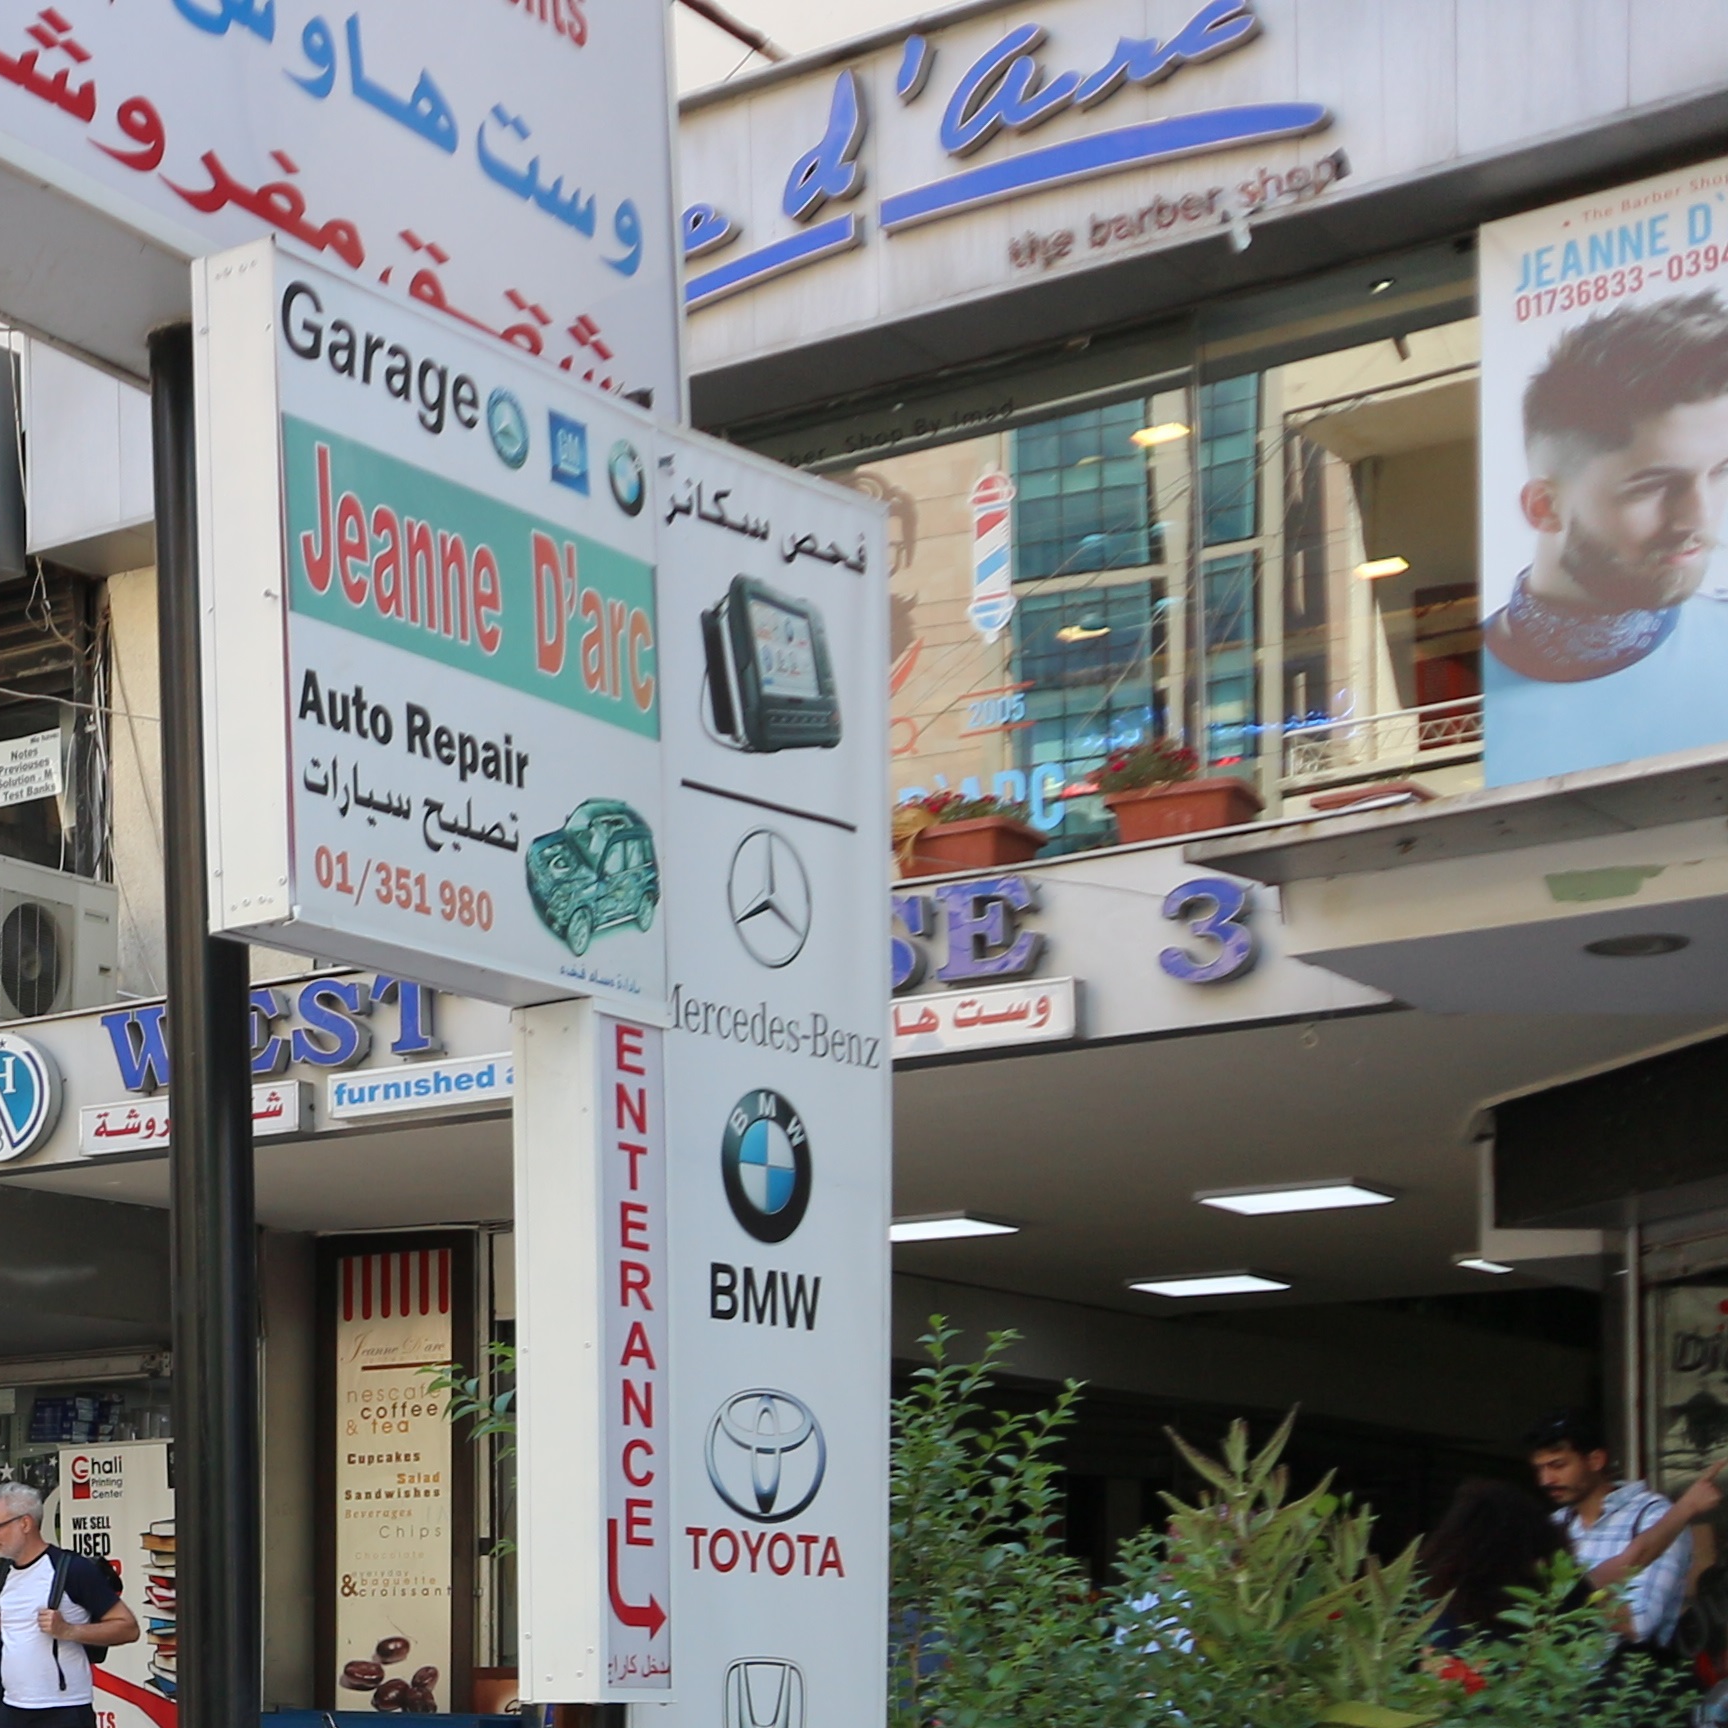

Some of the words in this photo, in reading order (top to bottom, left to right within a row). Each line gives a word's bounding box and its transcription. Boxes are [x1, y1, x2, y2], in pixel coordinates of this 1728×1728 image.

[477, 102, 642, 277] وست
[1582, 207, 1613, 223] The
[1621, 186, 1682, 212] Barber
[1009, 228, 1075, 270] the
[1088, 185, 1221, 249] barber
[1238, 148, 1349, 208] shop
[1515, 213, 1669, 293] JEANNE
[281, 281, 481, 434] Garage
[844, 428, 904, 453] Shop
[914, 416, 941, 437] By
[780, 532, 867, 574] فحص
[301, 442, 503, 656] Jeanne
[531, 528, 655, 711] D'arc
[967, 693, 1025, 727] 2005
[298, 668, 393, 746] Auto
[407, 702, 530, 788] Repair
[11, 748, 38, 760] Notes
[3, 789, 24, 801] Test
[27, 782, 56, 796] Banks
[303, 756, 412, 828] سيارات
[422, 795, 520, 853] تصليح
[315, 844, 431, 915] 01/351
[440, 879, 494, 933] 980
[1159, 877, 1256, 983] 3
[953, 994, 1052, 1029] وست
[335, 1065, 496, 1107] furnished
[731, 1092, 805, 1148] BMW
[615, 1024, 656, 1546] ENTERANCE
[710, 1262, 821, 1331] BMW
[340, 1329, 398, 1362] Jeanne
[361, 1401, 438, 1419] coffee
[346, 1419, 358, 1436] &
[372, 1419, 409, 1434] tea
[72, 1455, 122, 1479] Ghali
[347, 1452, 420, 1465] Cupcakes
[91, 1478, 123, 1488] Printing
[92, 1490, 123, 1499] Center
[345, 1488, 440, 1500] Sandwishes
[397, 1472, 440, 1484] Salad
[72, 1517, 87, 1530] WE
[90, 1516, 110, 1529] SELL
[345, 1509, 412, 1519] Beverages
[73, 1533, 110, 1556] USED
[379, 1525, 441, 1540] Chips
[355, 1551, 424, 1560] Chocolate
[686, 1527, 846, 1578] TOYOTA
[341, 1574, 358, 1597] &
[352, 1569, 409, 1578] everyday
[361, 1576, 436, 1587] baguette
